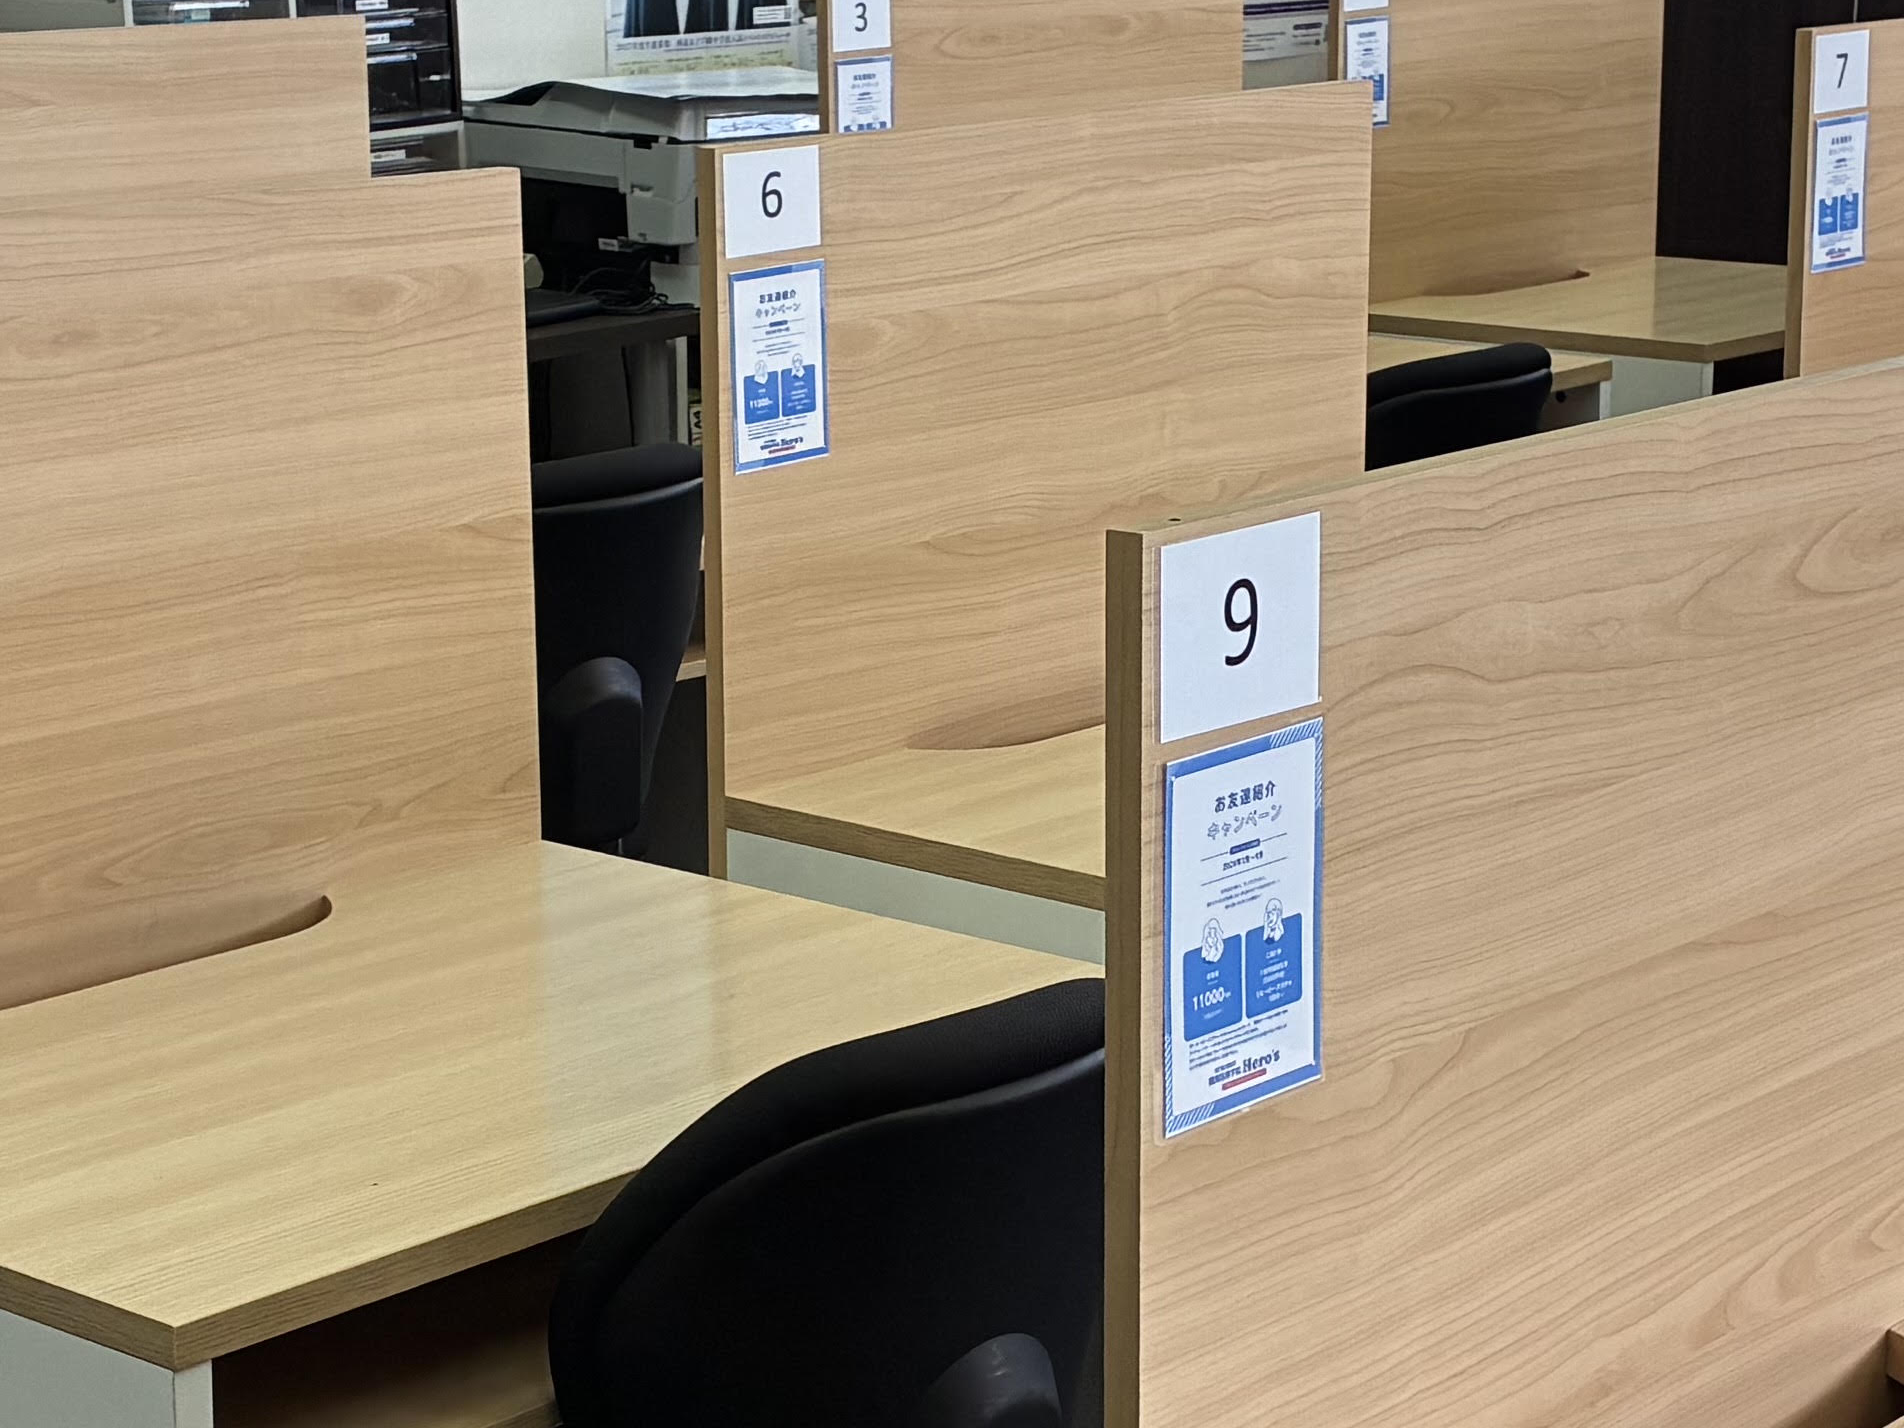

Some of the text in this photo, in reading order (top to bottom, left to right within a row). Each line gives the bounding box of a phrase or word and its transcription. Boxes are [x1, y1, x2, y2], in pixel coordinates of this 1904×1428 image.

[854, 2, 868, 33] 3
[1836, 52, 1849, 89] 7
[761, 171, 784, 219] 6
[1223, 578, 1259, 667] 9
[1214, 779, 1276, 814] お友達紹介
[1206, 804, 1283, 841] キャンペーン
[1242, 1049, 1281, 1074] Hero's
